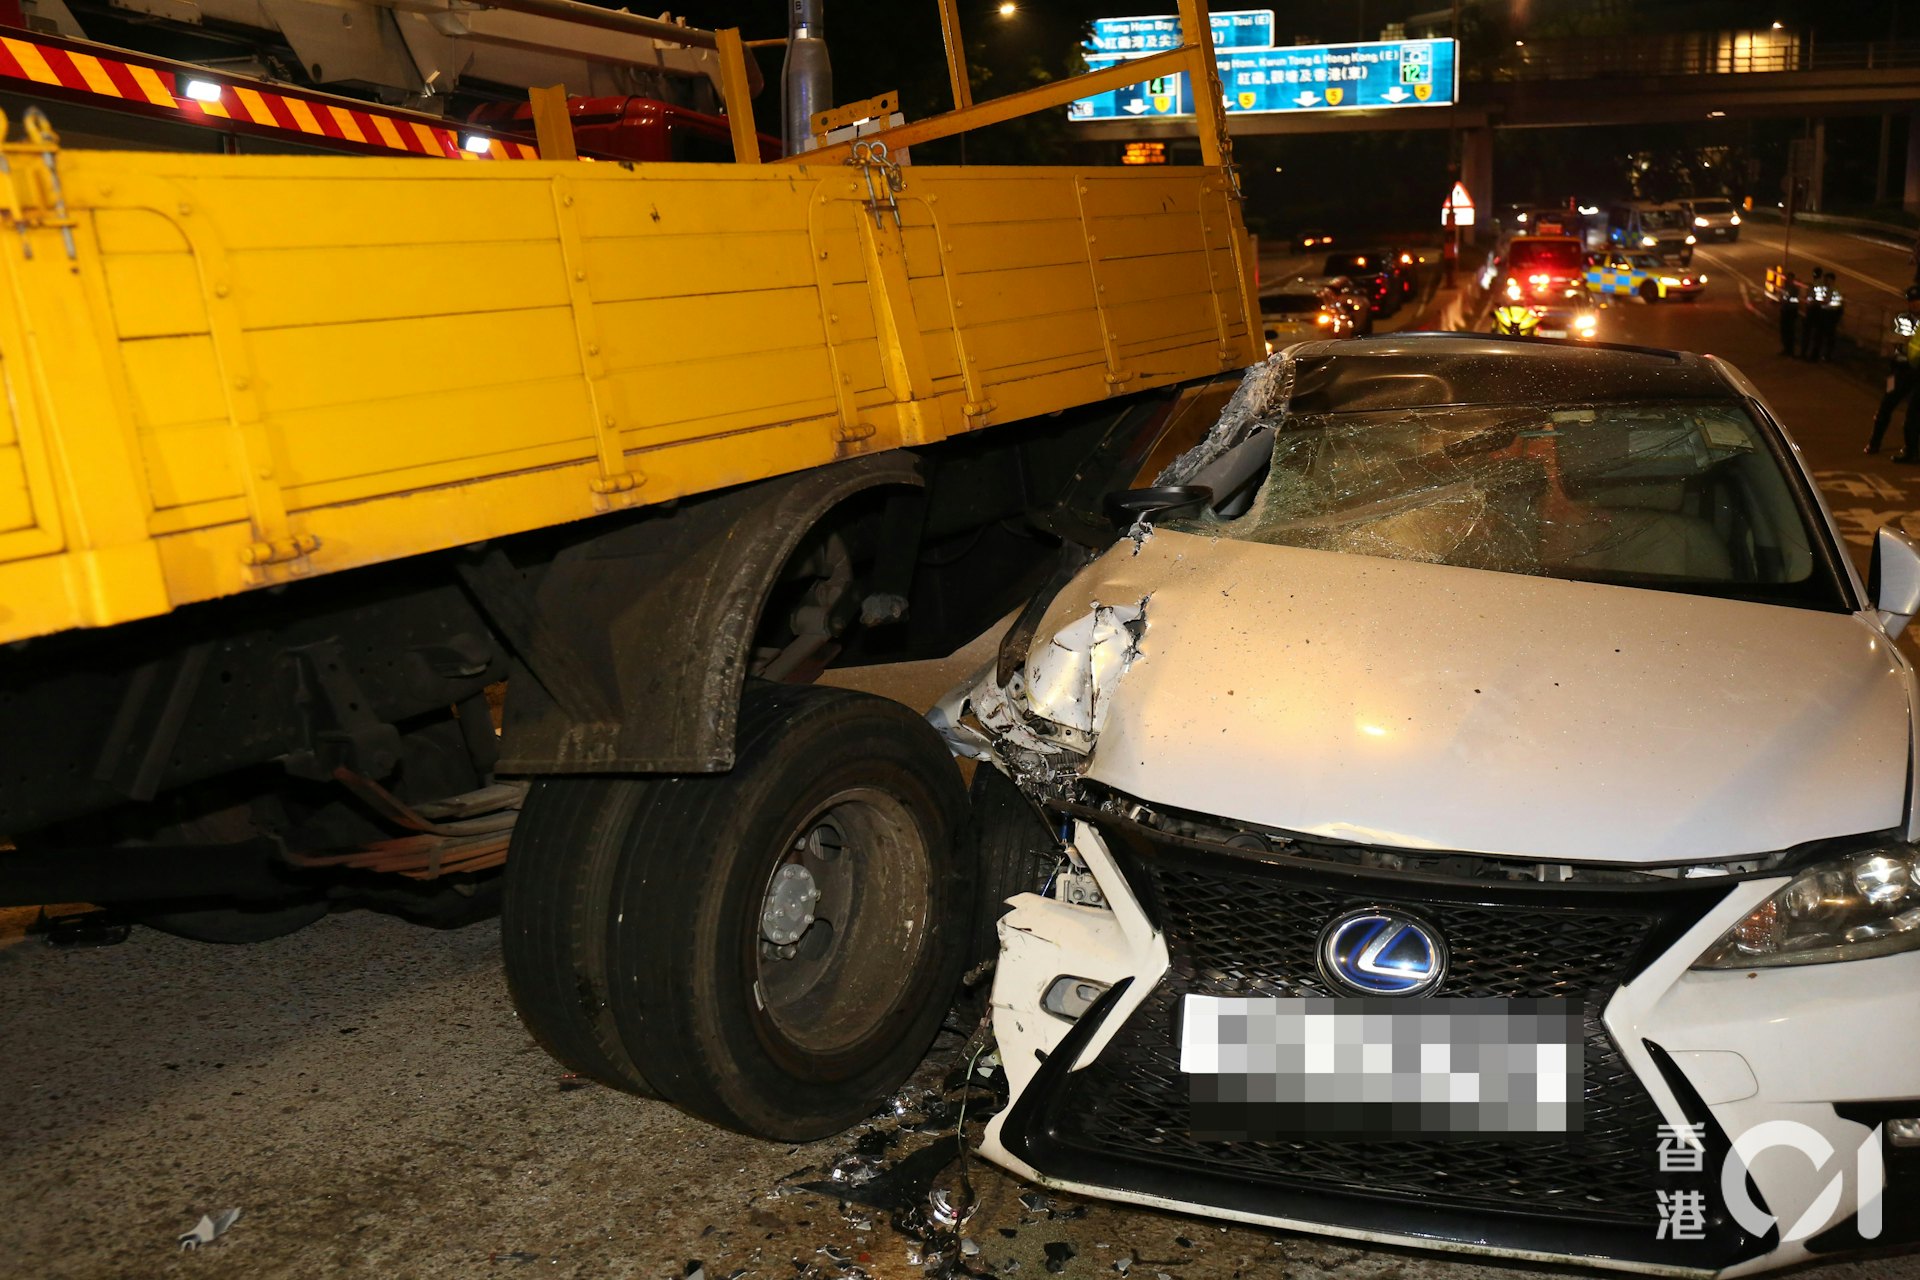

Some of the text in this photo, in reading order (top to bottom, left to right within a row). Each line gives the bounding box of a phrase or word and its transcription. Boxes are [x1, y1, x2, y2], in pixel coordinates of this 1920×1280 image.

[1103, 24, 1130, 34] Hung
[1130, 22, 1154, 31] Hom
[1154, 20, 1174, 31] Bay
[1233, 16, 1253, 26] Tsui
[1254, 14, 1270, 26] (E)
[1259, 57, 1287, 67] Kwun
[1288, 55, 1313, 66] Tong
[1323, 54, 1351, 64] Hong
[1351, 52, 1378, 63] Kong
[1380, 50, 1399, 61] (E)
[1403, 64, 1420, 82] 12
[1151, 78, 1163, 94] 4
